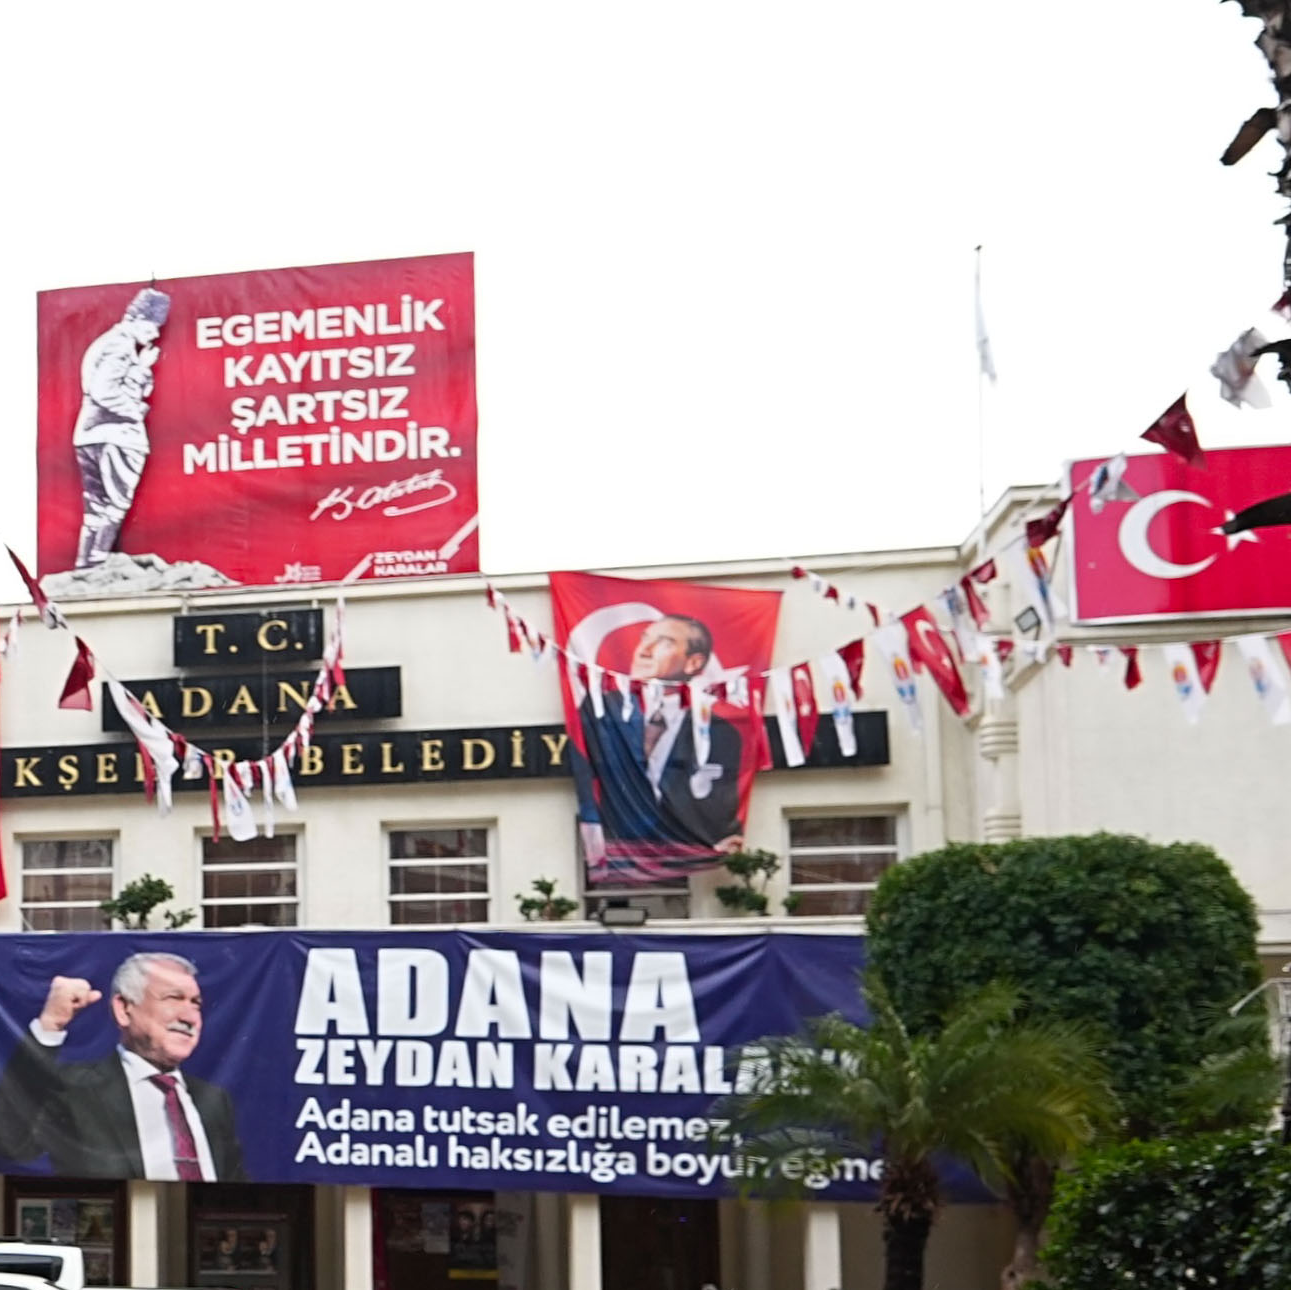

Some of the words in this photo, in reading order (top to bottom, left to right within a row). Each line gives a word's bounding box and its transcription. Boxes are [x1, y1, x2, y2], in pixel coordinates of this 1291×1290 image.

[196, 294, 445, 349] EGEMENLİK
[224, 343, 416, 388] KAYITSIZ
[230, 386, 409, 435] ŞARTSIZ
[183, 421, 462, 475] MİLLETİNDİR.
[196, 624, 239, 655] T.
[257, 619, 304, 651] C.
[139, 680, 358, 719] ADANA
[294, 947, 701, 1042] ADANA
[294, 1037, 515, 1089] ZEYDAN
[295, 1096, 416, 1132] Adana
[423, 1102, 539, 1137] tutsak
[546, 1103, 743, 1148] edilemez,
[295, 1130, 439, 1168] Adanalı
[448, 1134, 637, 1184] haksızlığa
